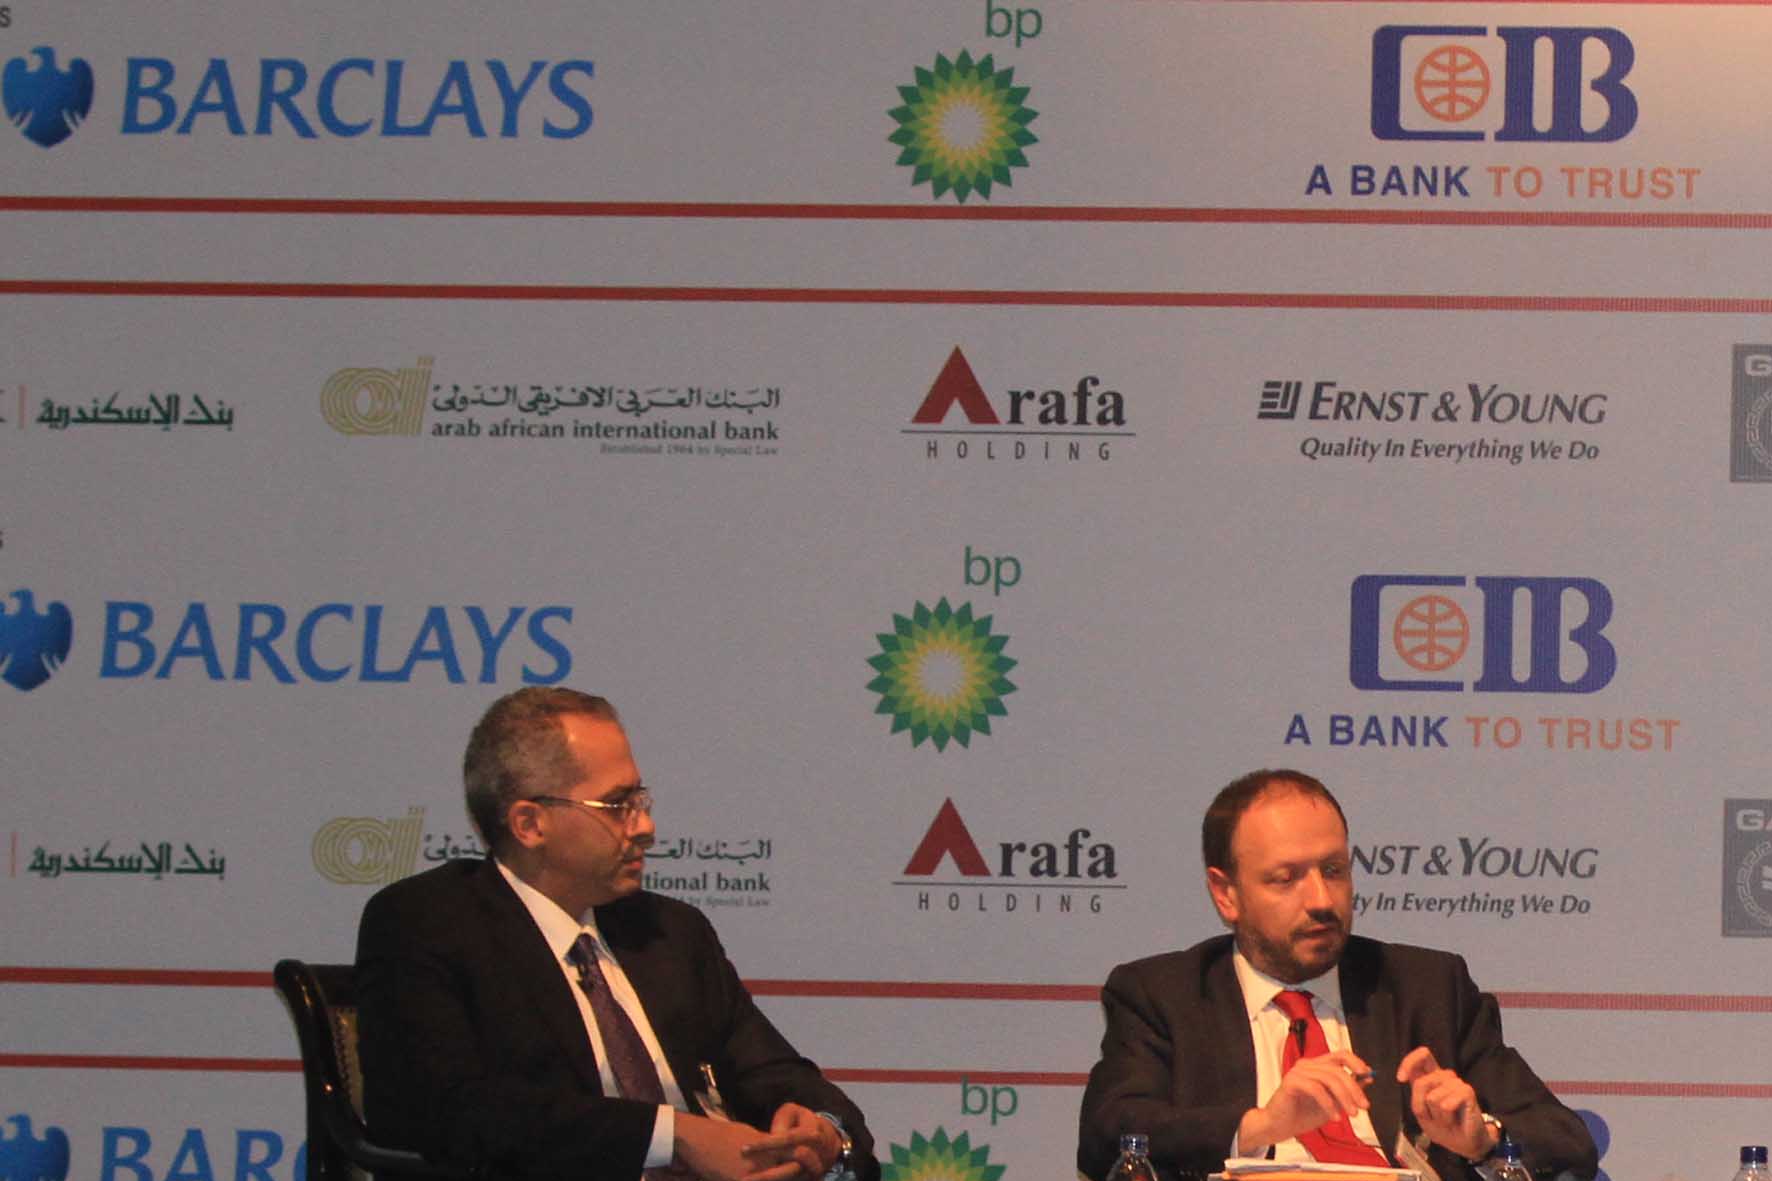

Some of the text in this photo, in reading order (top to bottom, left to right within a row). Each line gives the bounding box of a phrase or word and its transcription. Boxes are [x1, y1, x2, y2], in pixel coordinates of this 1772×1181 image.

[985, 0, 1043, 48] bp
[119, 56, 597, 140] BARCLAYS
[1370, 24, 1640, 142] CIB
[1304, 164, 1702, 200] A BANK TO TRUST
[911, 344, 1127, 426] Arafa
[1308, 380, 1608, 424] ERNST & YOUNG
[183, 392, 235, 431] بنك
[432, 418, 779, 441] arab african international bank
[926, 439, 1111, 462] HOLDING
[1300, 436, 1600, 465] Quality In Everything We Do
[963, 544, 1023, 596] bp
[99, 601, 576, 685] BARCLAYS
[1349, 574, 1619, 694] CIB
[1283, 712, 1681, 752] A BANK TO TRUST
[903, 796, 1118, 878] Arafa
[1350, 836, 1599, 878] NST & YOUNG
[173, 841, 226, 881] بنك
[717, 872, 770, 891] bank
[918, 890, 1103, 912] HOLDING
[1376, 891, 1397, 912] In
[1402, 891, 1514, 919] Everything
[1520, 894, 1554, 914] We
[1560, 893, 1592, 914] Do
[960, 1073, 1020, 1127] bp
